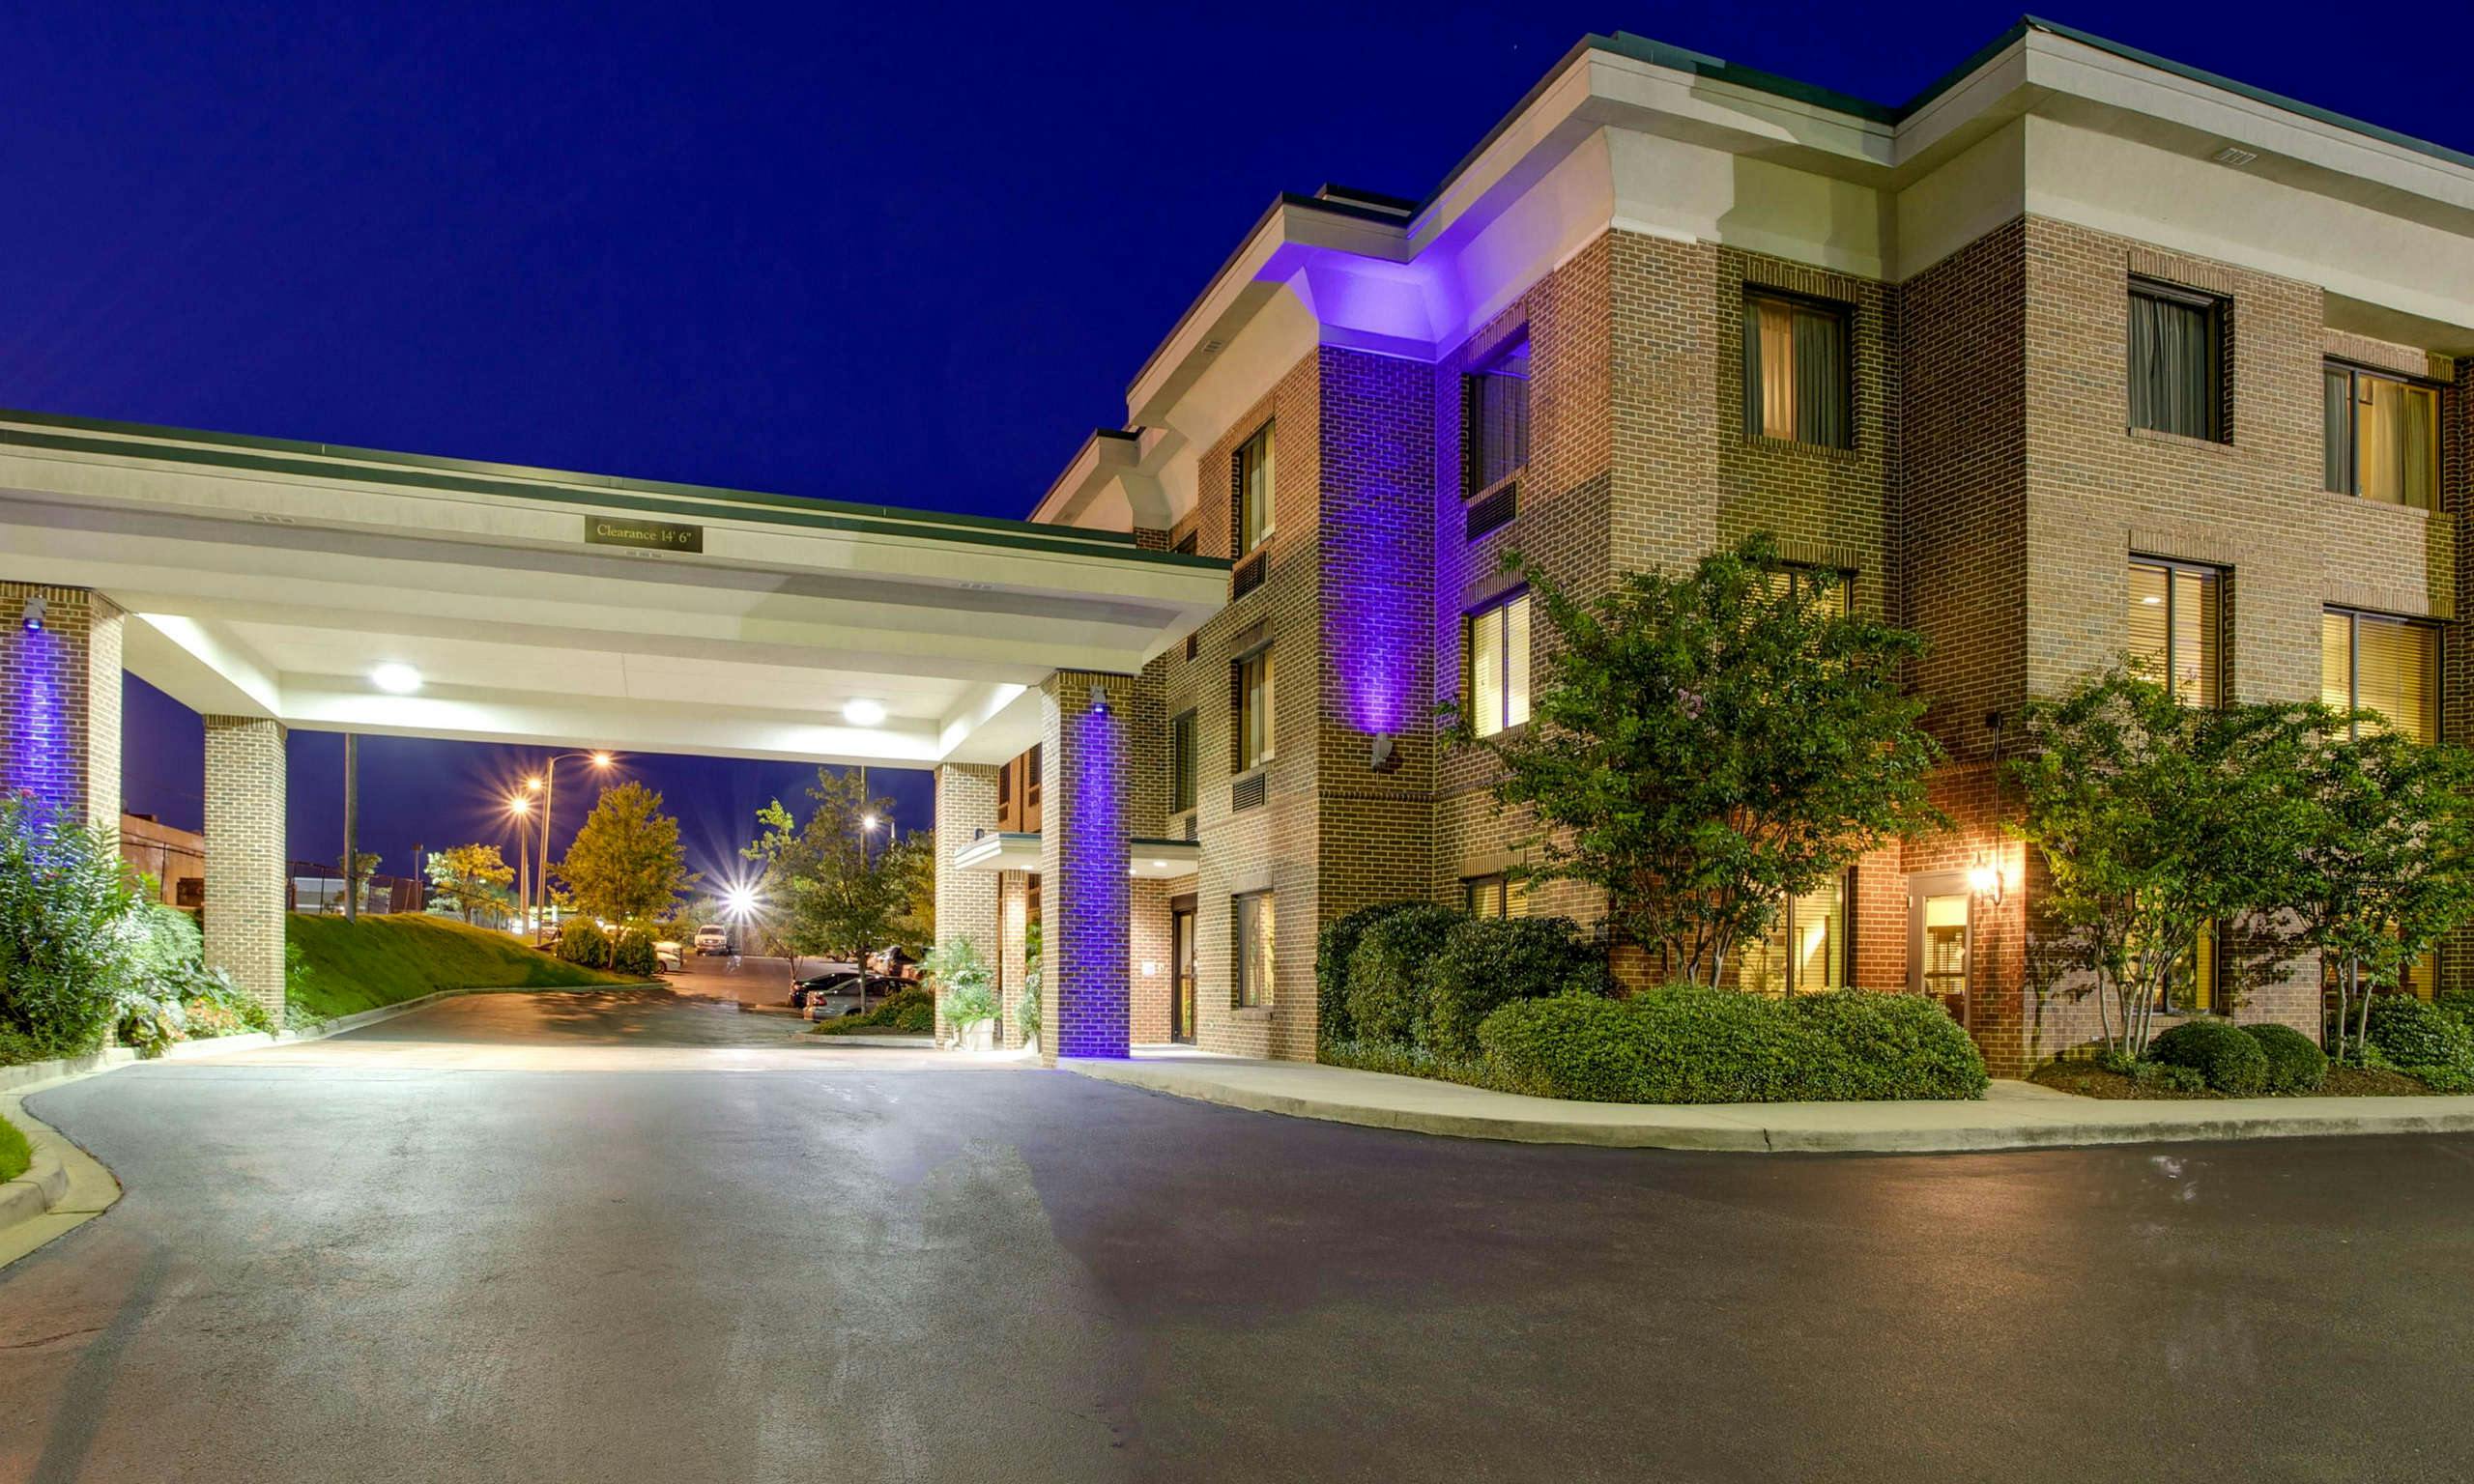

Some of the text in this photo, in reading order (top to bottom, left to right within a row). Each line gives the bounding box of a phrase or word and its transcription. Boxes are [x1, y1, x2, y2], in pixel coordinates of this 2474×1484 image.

[596, 524, 692, 543] Clearance 14' 6"
